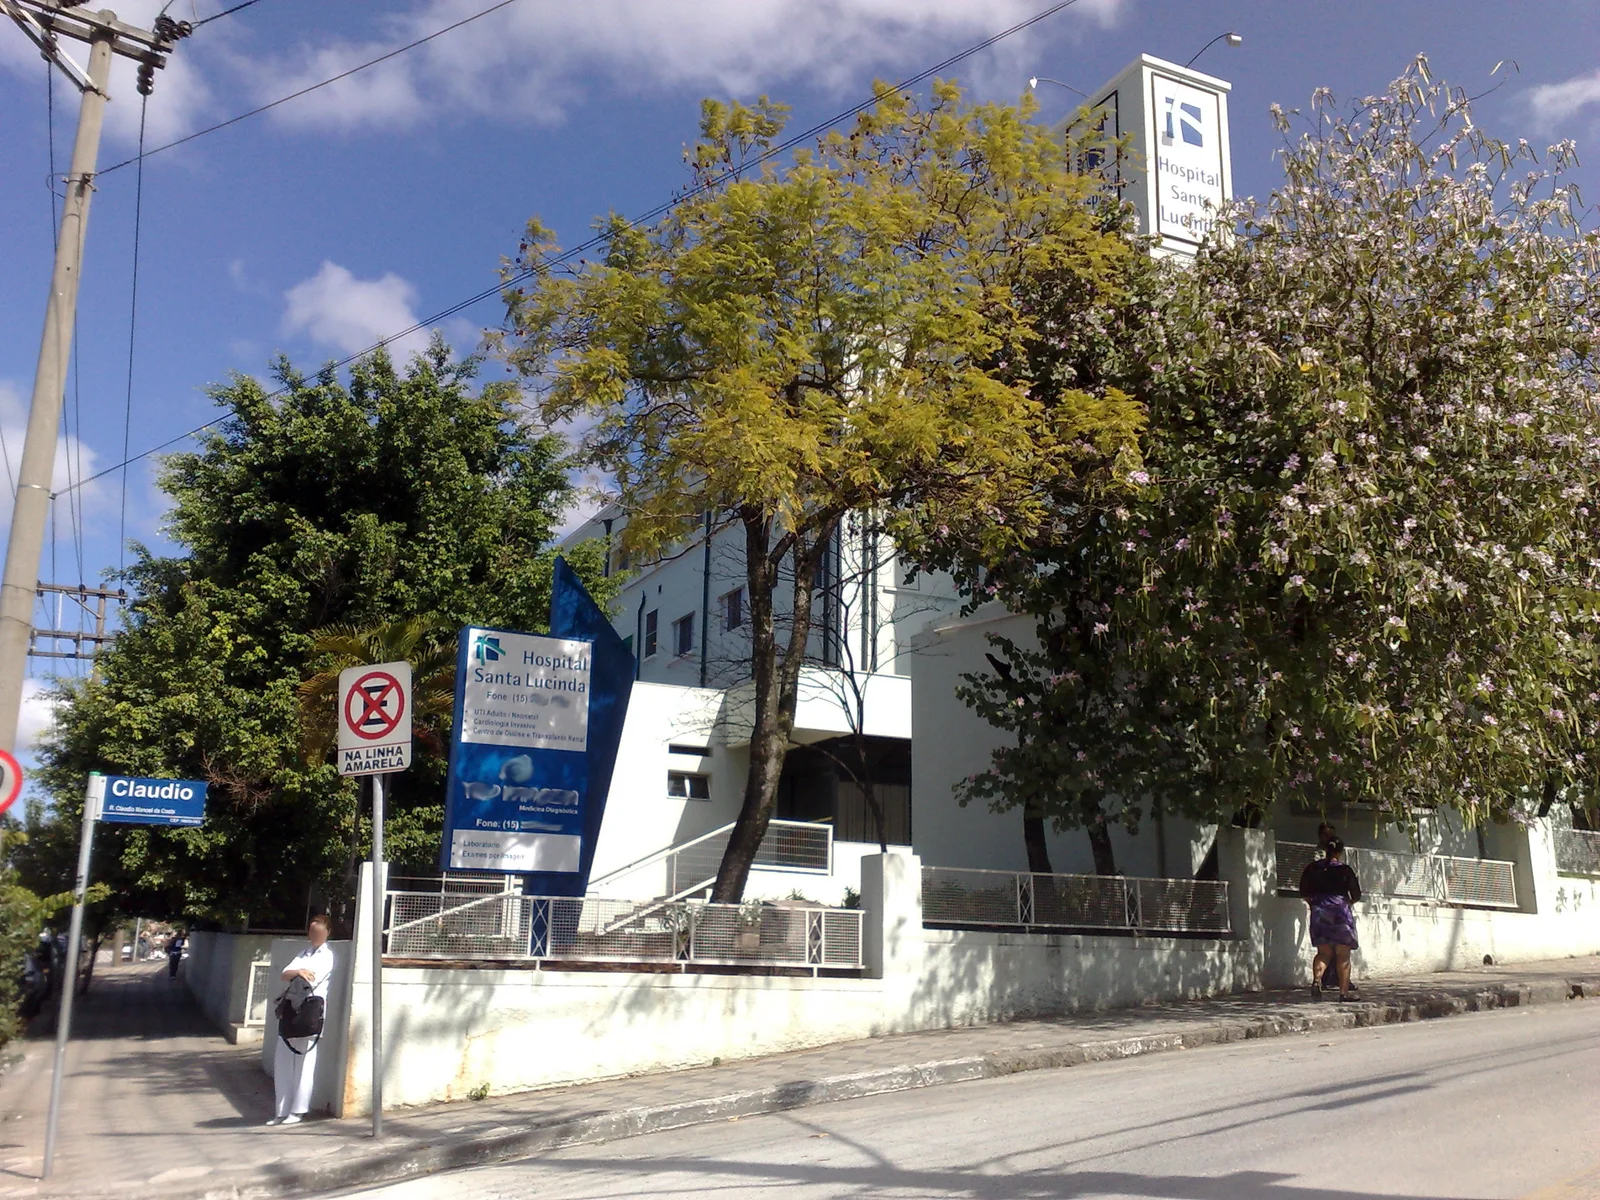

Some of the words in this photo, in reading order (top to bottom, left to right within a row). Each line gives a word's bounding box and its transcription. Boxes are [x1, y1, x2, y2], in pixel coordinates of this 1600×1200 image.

[1159, 156, 1220, 187] Hospital
[1161, 204, 1214, 233] Lucind
[523, 650, 587, 671] Hospital
[474, 667, 521, 686] Santa
[525, 673, 586, 693] Lucinda
[486, 691, 508, 701] Fone
[512, 694, 528, 703] (15)
[473, 718, 509, 727] Cardiologia
[472, 727, 494, 735] Centro
[344, 750, 362, 761] NA
[365, 745, 403, 758] LINHA
[344, 757, 404, 772] AMARELA
[112, 779, 193, 800] Claudio
[476, 818, 501, 828] Fone:
[502, 820, 520, 831] (15)
[462, 850, 488, 859] Exames
